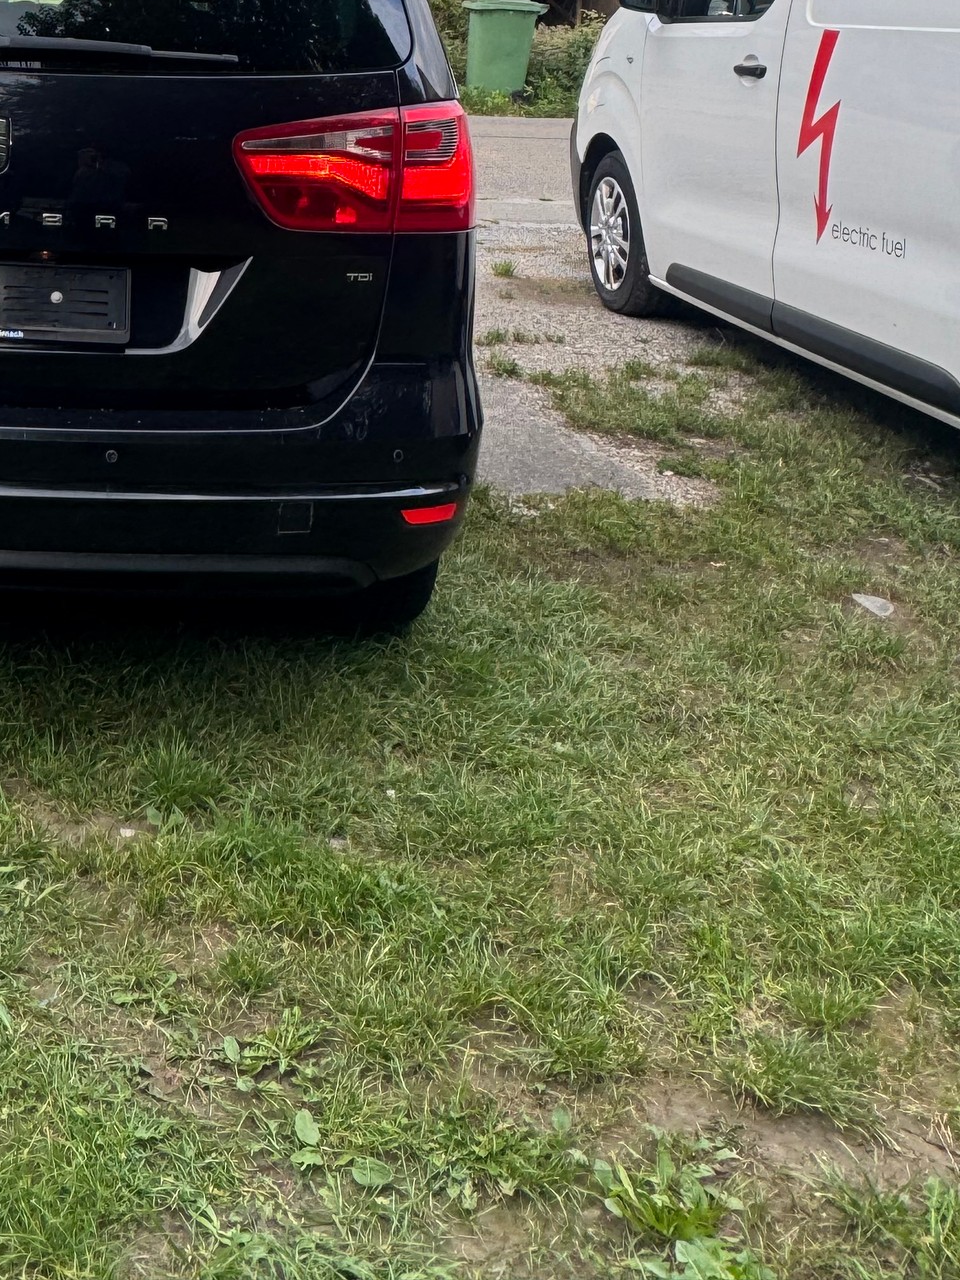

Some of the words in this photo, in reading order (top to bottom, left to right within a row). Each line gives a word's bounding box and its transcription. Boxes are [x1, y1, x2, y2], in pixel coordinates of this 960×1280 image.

[832, 221, 877, 251] electric
[882, 232, 906, 259] fuel
[346, 273, 373, 281] TDI
